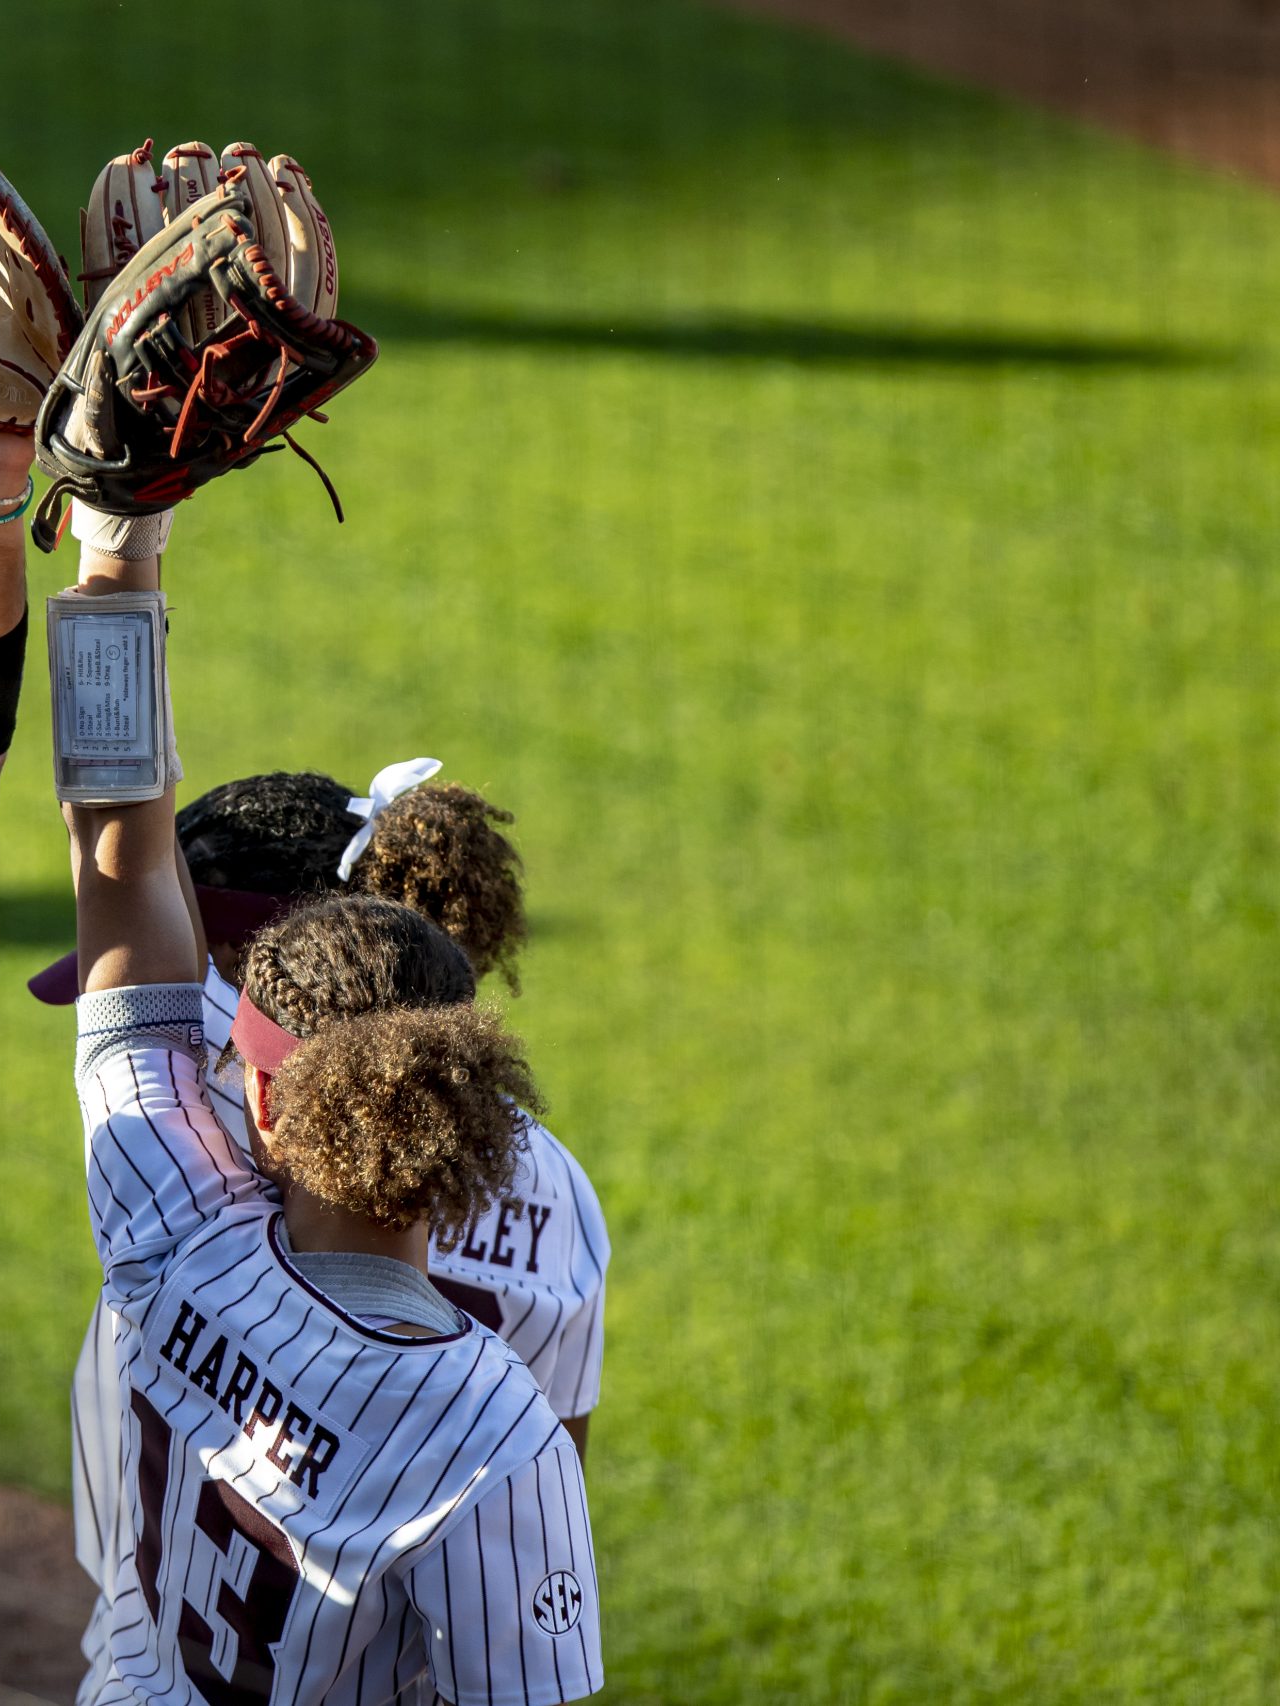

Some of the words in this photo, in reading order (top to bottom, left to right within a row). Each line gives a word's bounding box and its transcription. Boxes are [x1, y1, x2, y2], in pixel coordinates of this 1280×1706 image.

[106, 242, 195, 347] EASTON
[311, 204, 335, 296] A2000
[159, 1299, 340, 1501] HARPER
[533, 1573, 582, 1635] SEC
